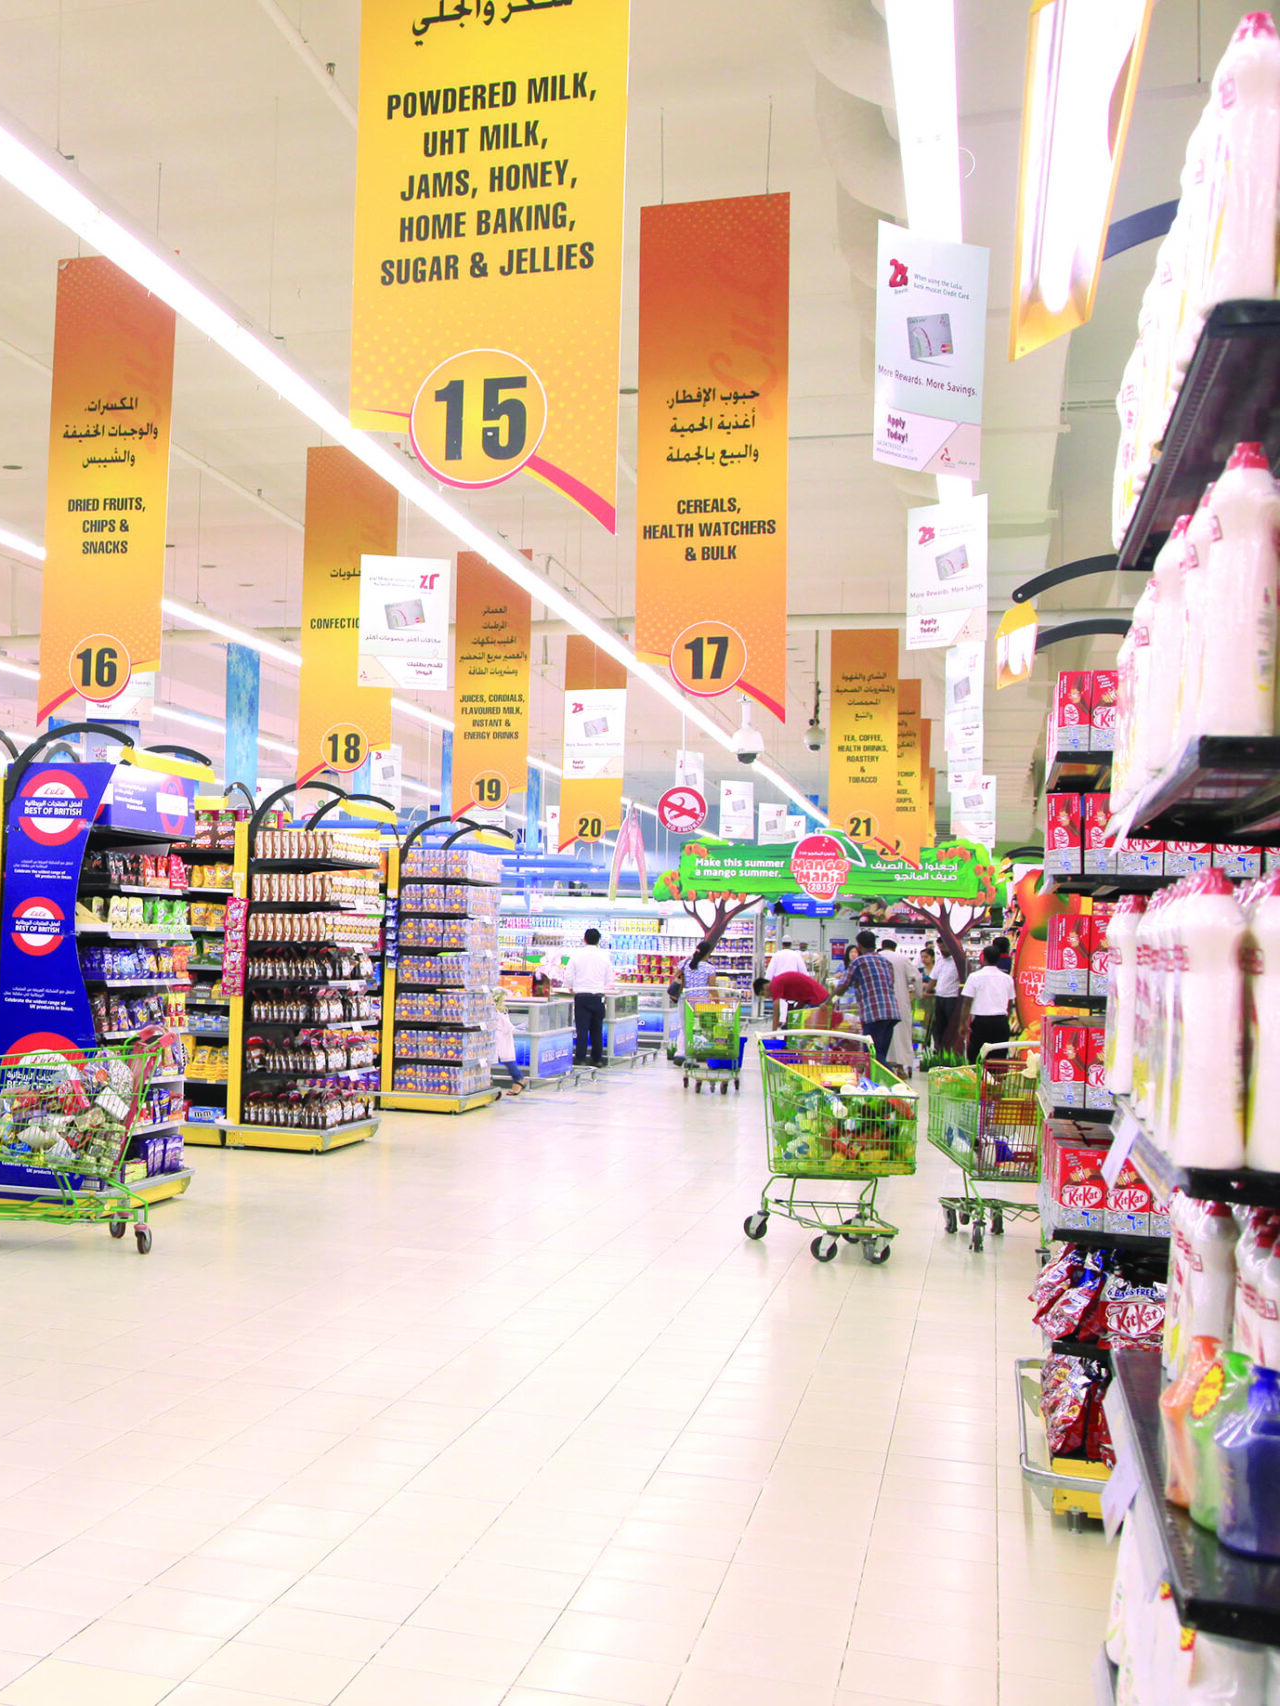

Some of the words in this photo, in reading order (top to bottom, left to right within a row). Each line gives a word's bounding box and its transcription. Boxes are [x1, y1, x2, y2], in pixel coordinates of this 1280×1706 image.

[387, 80, 517, 120] POWDERED
[527, 71, 596, 104] MILK,
[423, 127, 469, 157] UHT
[480, 120, 548, 151] MILK,
[401, 169, 478, 202] JAMS,
[489, 159, 577, 192] HONEY,
[399, 212, 466, 243] HOME
[476, 202, 575, 236] BAKING,
[381, 255, 459, 286] SUGAR
[470, 252, 488, 278] &
[500, 242, 595, 276] JELLIES
[878, 364, 893, 377] More
[926, 378, 945, 390] More
[720, 389, 760, 405] حبوب
[434, 376, 528, 461] 15
[670, 416, 713, 437] الحمية
[717, 407, 756, 435] أغذية
[888, 414, 906, 429] Apply
[63, 424, 104, 443] الخفيفة
[108, 422, 158, 441] والوجبات
[887, 428, 908, 444] Today!
[82, 448, 135, 468] والشيبس
[666, 446, 715, 465] بالجملة
[720, 444, 759, 466] والبيع
[68, 498, 99, 512] DRIED
[103, 497, 146, 512] FRUITS,
[677, 497, 741, 514] CEREALS,
[82, 519, 116, 533] CHIPS
[120, 519, 129, 533] &
[643, 524, 694, 539] HEALTH
[699, 520, 776, 537] WATCHERS
[82, 540, 128, 554] SNACKS
[685, 547, 696, 561] &
[702, 545, 737, 560] BULK
[920, 618, 937, 626] Apply
[920, 625, 939, 633] Today!
[77, 647, 119, 688] 16
[685, 636, 729, 680] 17
[460, 694, 486, 703] JUICES,
[488, 694, 525, 703] CORDIALS,
[461, 707, 501, 715] FLAVOURED
[503, 707, 522, 715] MILK,
[472, 719, 502, 727] INSTANT
[505, 719, 511, 727] &
[464, 732, 490, 740] ENERGY
[493, 731, 519, 739] DRINKS
[328, 732, 361, 764] 18
[475, 778, 501, 801] 19
[578, 817, 601, 837] 20
[666, 822, 676, 831] NO
[678, 812, 705, 832] SMOKING
[850, 817, 872, 836] 21
[695, 858, 723, 867] Make
[724, 858, 743, 867] this
[745, 860, 785, 868] summer
[704, 870, 737, 878] mango
[740, 870, 782, 878] summer.
[809, 882, 833, 891] 2015
[1069, 1187, 1098, 1207] KitKat
[1116, 1304, 1157, 1334] KitKat
